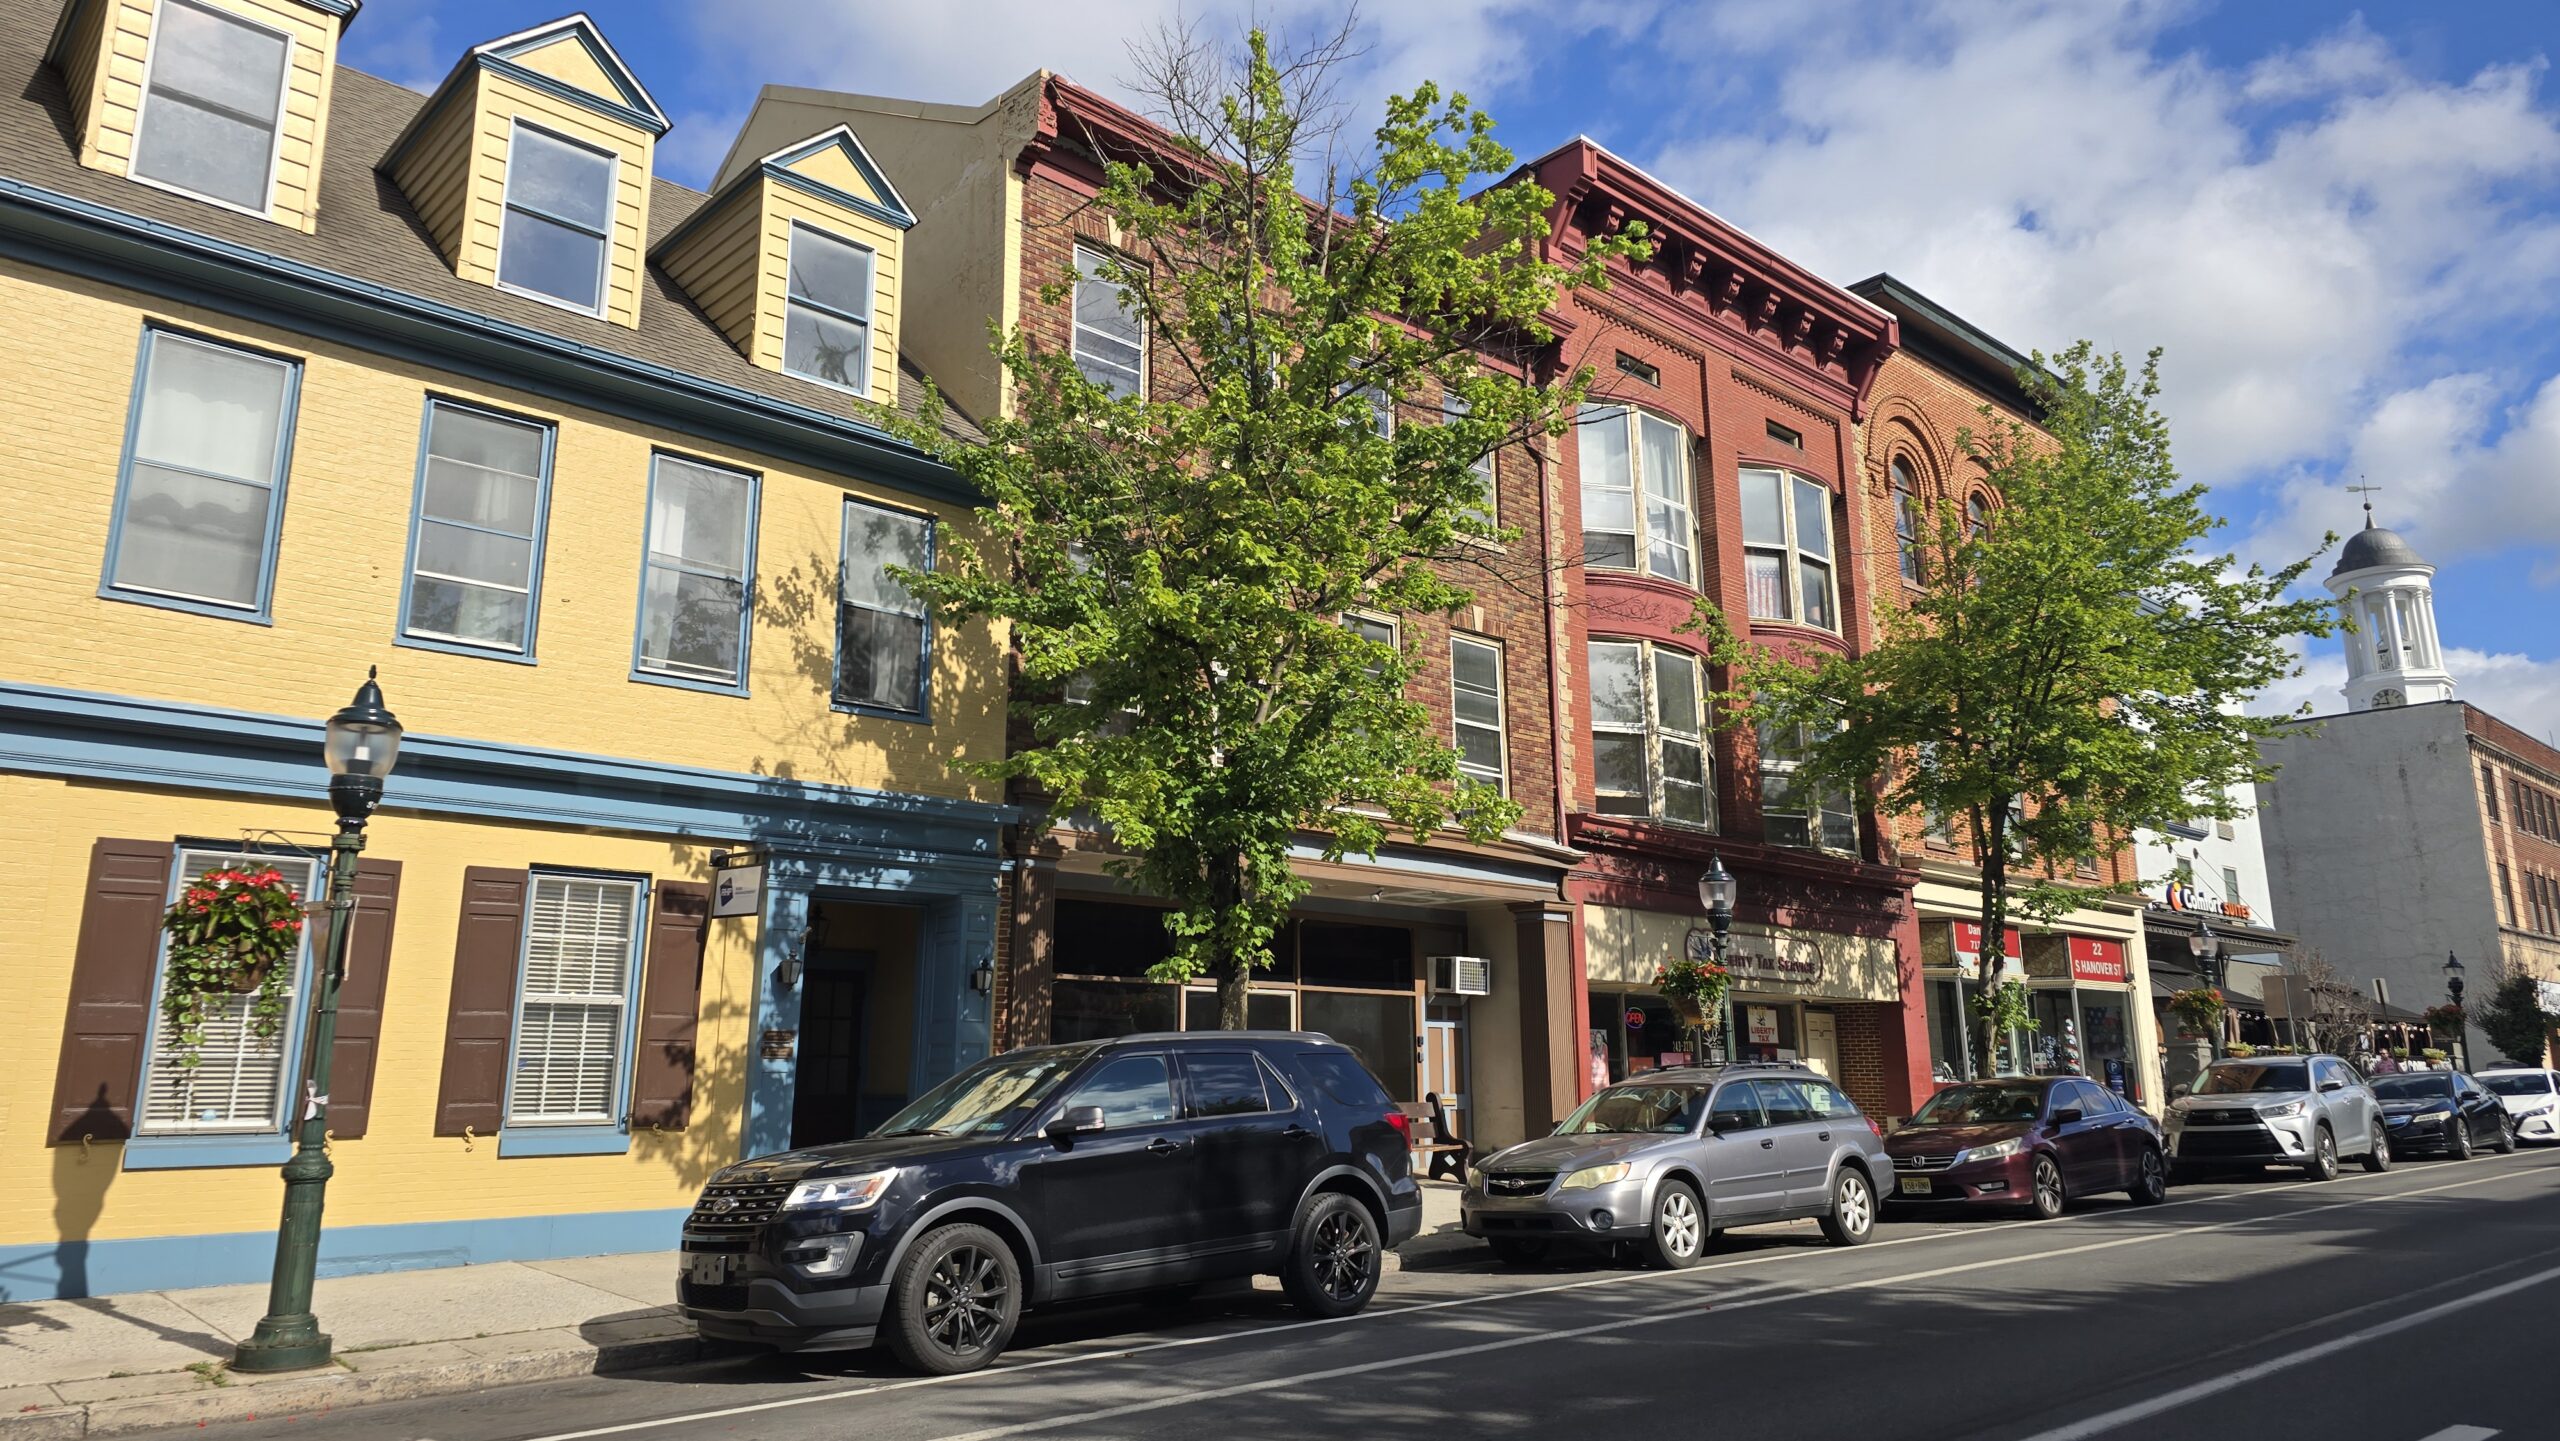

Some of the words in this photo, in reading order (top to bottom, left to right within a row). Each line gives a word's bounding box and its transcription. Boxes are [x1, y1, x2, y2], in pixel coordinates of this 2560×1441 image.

[2180, 888, 2224, 915] Comfort
[2223, 902, 2250, 918] SUITES
[2092, 942, 2103, 956] 22
[1728, 954, 1753, 968] ERTY
[2075, 959, 2081, 973] S
[2080, 960, 2113, 976] HANOVER
[2113, 963, 2121, 976] ST
[1625, 1012, 1645, 1024] OPEN
[1750, 1026, 1776, 1035] LIBERTY
[1757, 1034, 1770, 1043] TAX
[2110, 1062, 2118, 1072] P
